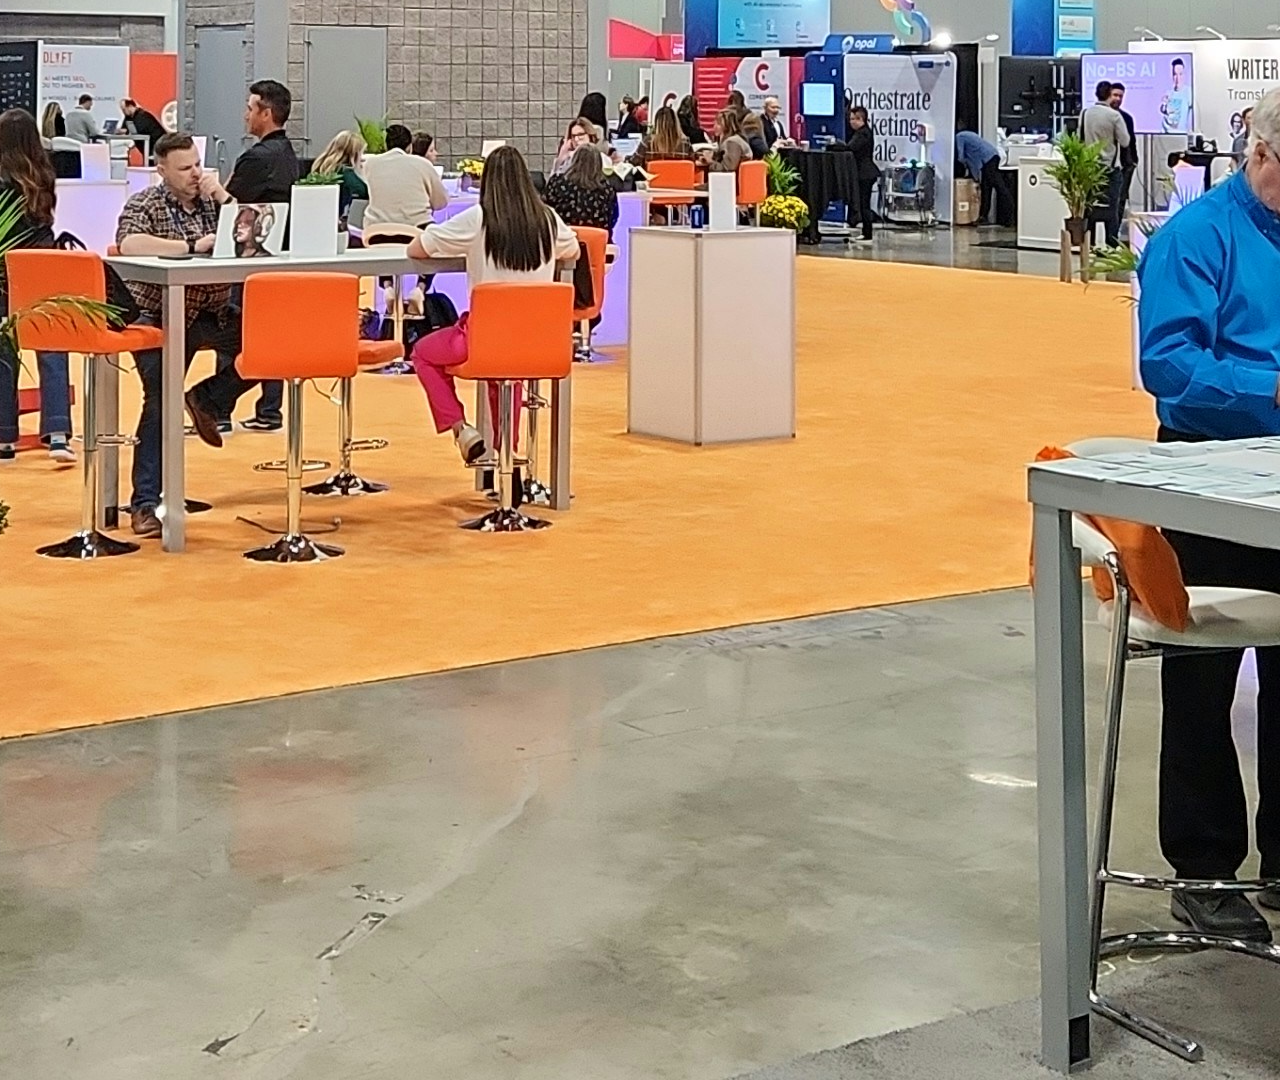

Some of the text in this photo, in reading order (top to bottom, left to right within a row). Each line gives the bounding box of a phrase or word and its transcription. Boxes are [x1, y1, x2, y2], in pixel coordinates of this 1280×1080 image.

[854, 38, 877, 51] opal
[1085, 61, 1156, 78] No-BS AI
[1227, 58, 1279, 80] WRITER
[844, 87, 931, 111] Orchestrate
[1227, 88, 1266, 101] Transf
[868, 112, 918, 143] keting
[874, 139, 897, 162] ale
